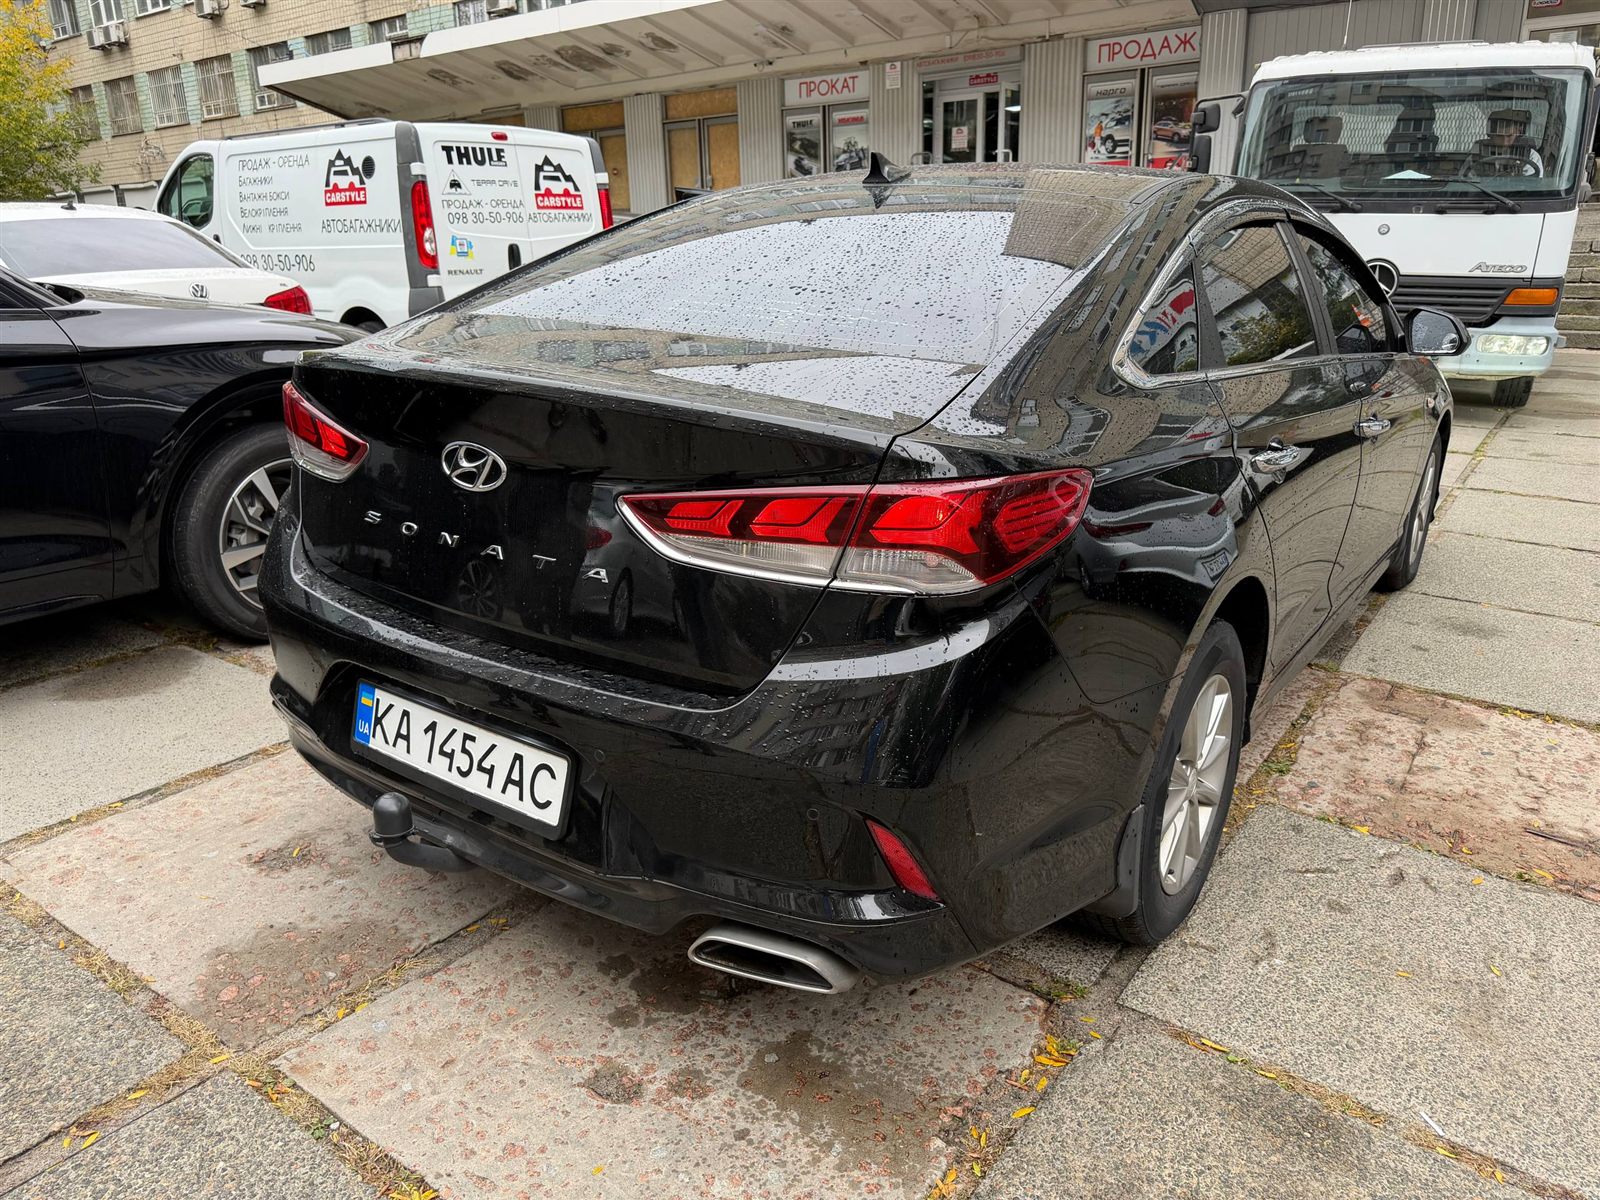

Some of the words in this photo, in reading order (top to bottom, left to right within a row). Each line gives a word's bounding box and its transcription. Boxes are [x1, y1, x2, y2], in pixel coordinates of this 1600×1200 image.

[1098, 32, 1197, 63] ПРОДАЖ
[798, 76, 859, 98] ПРОКАТ
[792, 120, 814, 128] THULE
[238, 158, 271, 171] ПРОДАЖ
[278, 154, 310, 168] ОРЕНДА
[441, 145, 506, 167] THULE
[325, 190, 366, 203] CARSTYLE
[441, 199, 484, 210] ПРОДАЖ
[489, 199, 524, 209] ОРЕНДА
[537, 196, 582, 207] CARSTYLE
[321, 218, 402, 234] АВТОБАГАЖНИКИ
[447, 212, 469, 224] 098
[471, 212, 524, 224] 30-50-906
[528, 213, 593, 223] АВТОБАГАЖНИКИ
[260, 253, 316, 272] 30-50-906
[364, 510, 609, 583] SONATA
[358, 719, 370, 736] UA
[371, 697, 411, 755] KA
[423, 720, 498, 790] 1454
[500, 752, 558, 810] AC
